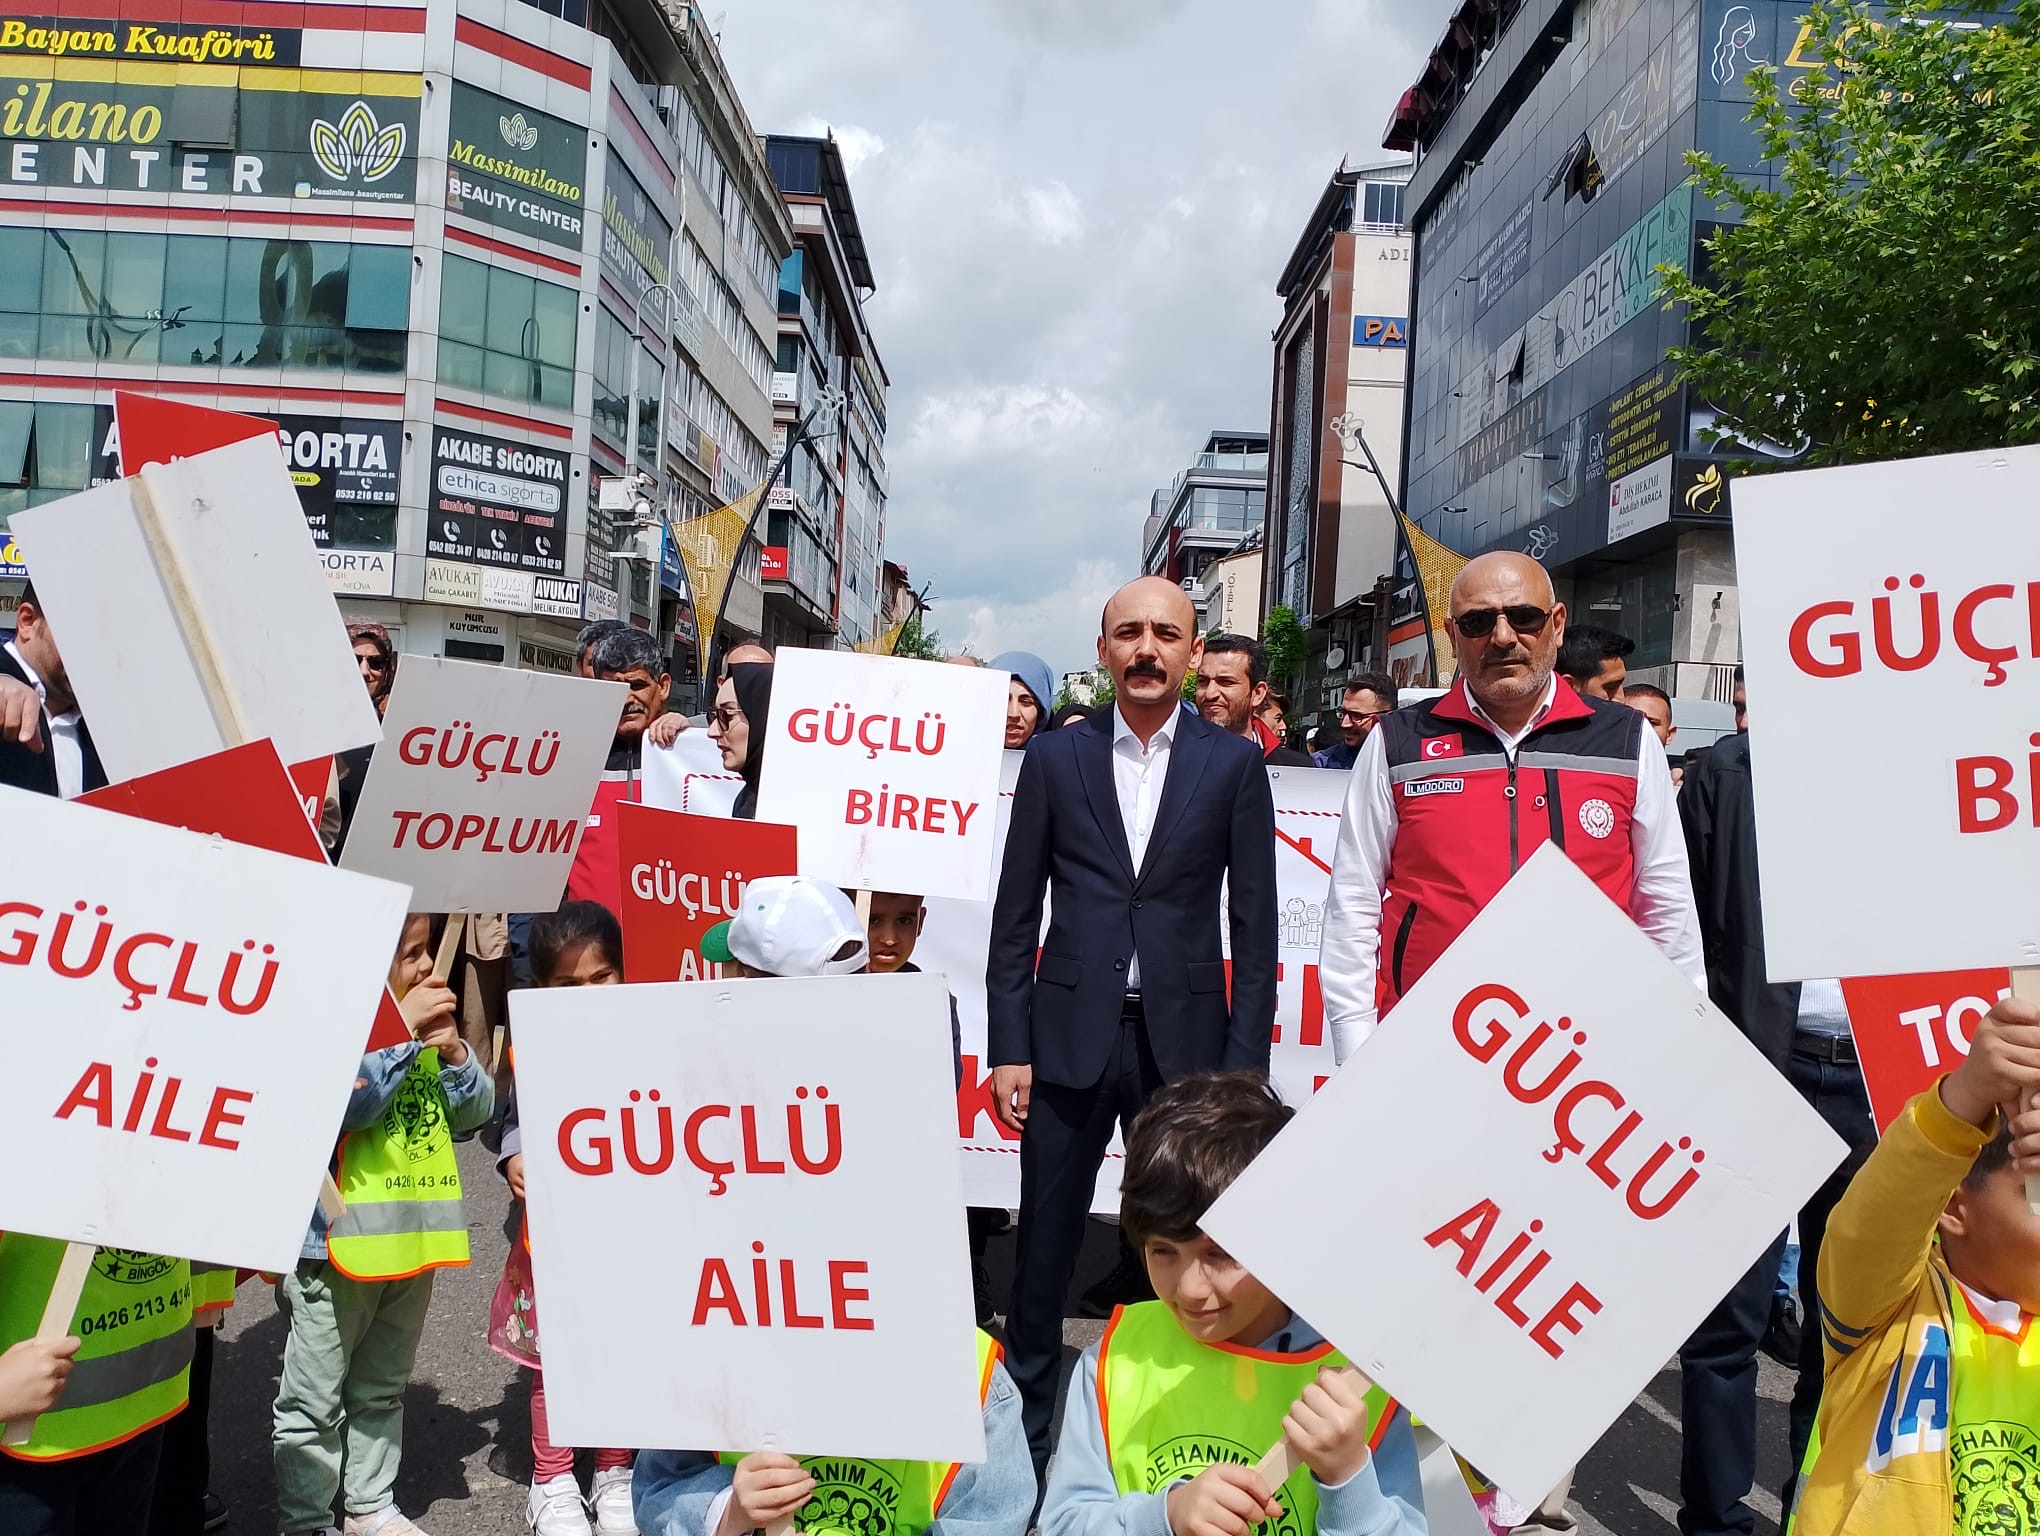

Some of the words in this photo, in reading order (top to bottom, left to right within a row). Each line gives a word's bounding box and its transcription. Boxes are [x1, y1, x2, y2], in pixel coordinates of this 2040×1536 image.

[0, 20, 117, 55] Bayan
[124, 26, 276, 62] Kuaförü
[3, 82, 162, 144] ilano
[11, 143, 264, 194] ENTER
[449, 139, 580, 200] Massimilano
[449, 177, 517, 212] BEAUTY
[519, 202, 581, 235] CENTER
[603, 185, 668, 286] Massimilano
[605, 226, 637, 281] BEAUTY
[1583, 208, 1662, 332] BEKKE
[1365, 319, 1407, 346] PA
[437, 437, 493, 467] AKABE
[496, 446, 564, 481] SİGORTA
[445, 472, 497, 494] ethica
[501, 482, 554, 506] sigorta
[429, 567, 479, 586] AVUKAT
[484, 575, 532, 592] AVUKAT
[535, 578, 580, 602] AVUKAT
[450, 622, 499, 634] KUYUMCUSU
[464, 612, 484, 623] NUR
[399, 720, 561, 782] GÜÇLÜ
[787, 702, 946, 759] GÜÇLÜ
[392, 811, 578, 854] TOPLUM
[845, 783, 979, 836] BİREY
[631, 859, 746, 920] GÜÇLÜ
[0, 900, 280, 1015] GÜÇLÜ
[1898, 987, 2012, 1068] TO
[53, 1056, 254, 1151] AİLE
[1451, 982, 1706, 1221] GÜÇLÜ
[557, 1085, 843, 1196] GÜÇLÜ
[440, 1174, 457, 1188] 46
[127, 1260, 171, 1281] BİNGÖL
[691, 1240, 875, 1331] AİLE
[1423, 1197, 1604, 1361] AİLE
[81, 1307, 130, 1336] 0426
[134, 1297, 165, 1322] 213
[809, 1463, 866, 1485] ANIM
